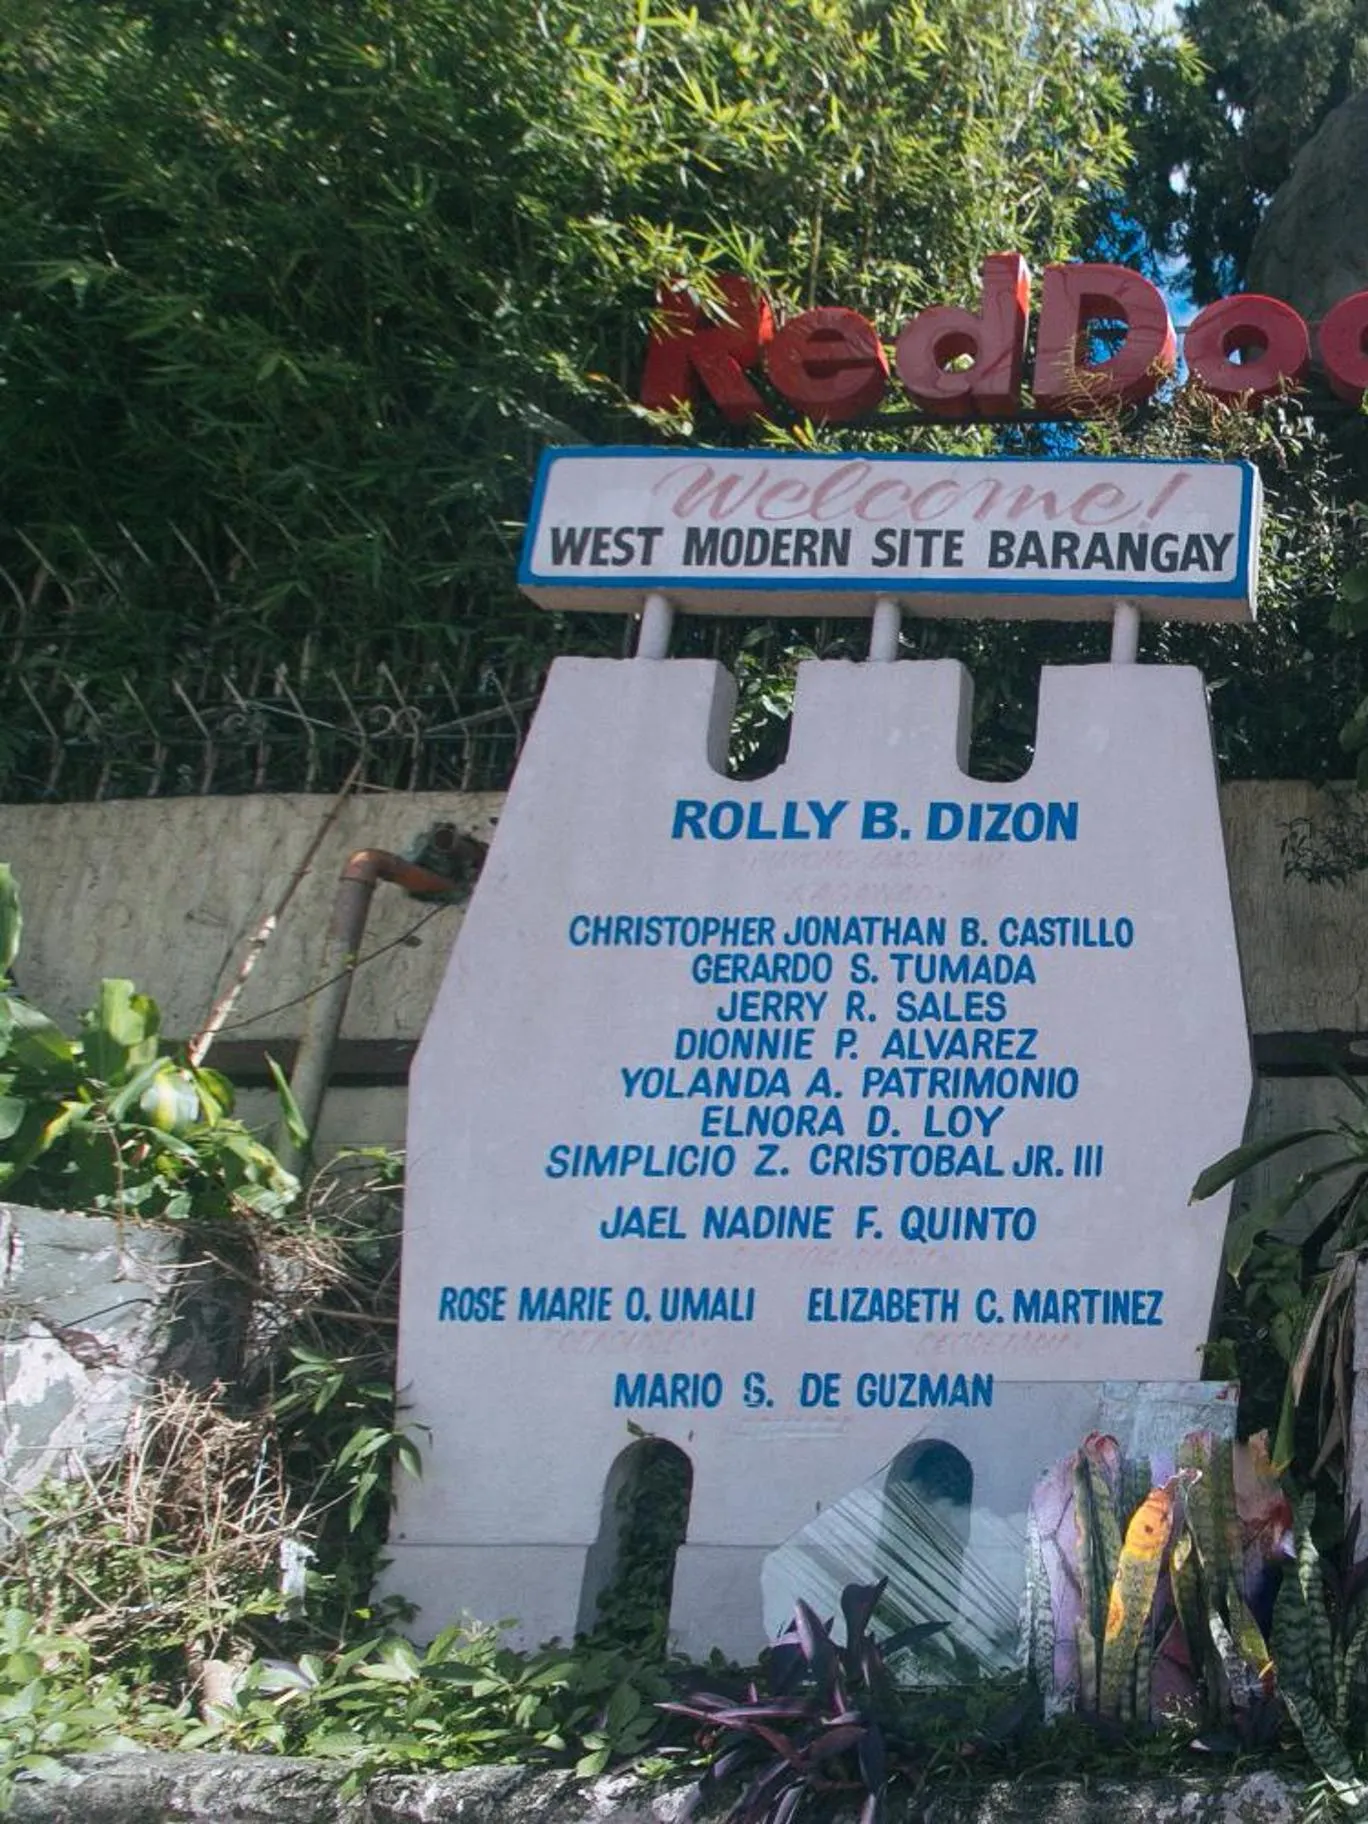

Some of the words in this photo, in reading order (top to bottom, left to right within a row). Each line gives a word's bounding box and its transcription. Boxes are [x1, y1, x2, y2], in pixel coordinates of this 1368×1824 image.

[654, 460, 1191, 528] Welcome!
[550, 526, 664, 567] WEST
[682, 526, 851, 568] MODERN
[871, 526, 964, 567] SITE
[988, 529, 1234, 572] BARANGAY
[671, 798, 848, 843] ROLLY
[858, 799, 913, 843] B.
[923, 799, 1080, 845] DIZON
[568, 913, 777, 950] CHRISTOPHER
[780, 913, 948, 948] JONATHAN
[958, 915, 986, 951] B.
[996, 913, 1136, 950] CASTILLO
[690, 949, 833, 989] GERARDO
[847, 951, 878, 989] S.
[888, 950, 1039, 989] TUMADA
[714, 987, 829, 1024] JERRY
[843, 987, 877, 1023] R.
[895, 989, 1008, 1025] SALES
[672, 1025, 814, 1063] DIONNIE
[832, 1026, 859, 1063] P.
[879, 1025, 1039, 1063] ALVAREZ
[620, 1064, 792, 1103] YOLANDA
[803, 1064, 842, 1099] A.
[859, 1063, 1080, 1103] PATRIMONIO
[698, 1102, 846, 1141] ELNORA
[866, 1102, 901, 1141] D.
[922, 1102, 1005, 1141] LOY
[543, 1141, 737, 1180] SIMPLICIO
[751, 1141, 788, 1179] Z.
[807, 1141, 1004, 1180] CRISTOBAL
[1009, 1142, 1063, 1179] JR.
[1071, 1141, 1104, 1178] III
[596, 1203, 686, 1242] JAEL
[700, 1202, 837, 1242] NADINE
[852, 1203, 884, 1241] F.
[896, 1202, 1040, 1244] QUINTO
[437, 1284, 506, 1323] ROSE
[517, 1284, 613, 1324] MARIE
[622, 1285, 649, 1324] O.
[657, 1286, 757, 1325] UMALI
[805, 1285, 962, 1325] ELIZABETH
[972, 1287, 1003, 1326] C.
[1010, 1285, 1165, 1328] MARTINEZ
[611, 1369, 725, 1411] MARIO
[741, 1371, 771, 1410] S.
[797, 1370, 841, 1409] DE
[853, 1370, 995, 1412] GUZMAN
